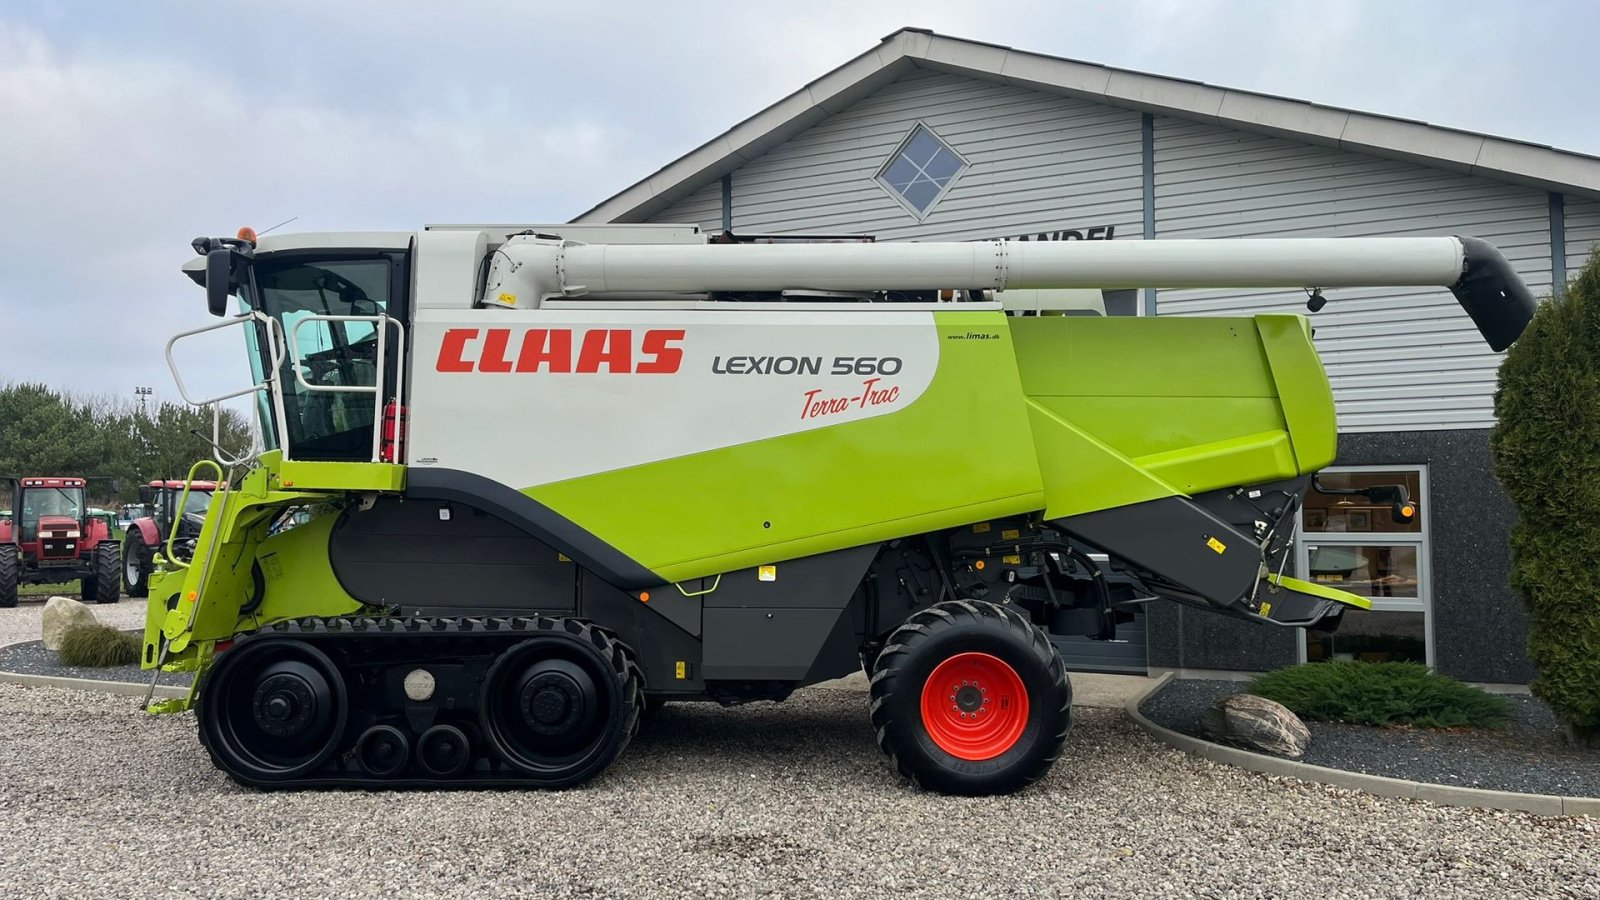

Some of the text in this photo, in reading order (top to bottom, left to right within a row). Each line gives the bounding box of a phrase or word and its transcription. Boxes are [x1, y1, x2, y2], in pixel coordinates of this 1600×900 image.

[435, 328, 686, 374] CLAAS
[947, 332, 1001, 340] www.limas.dk
[711, 356, 903, 376] LEXION 560
[800, 377, 900, 420] Terra-Trac
